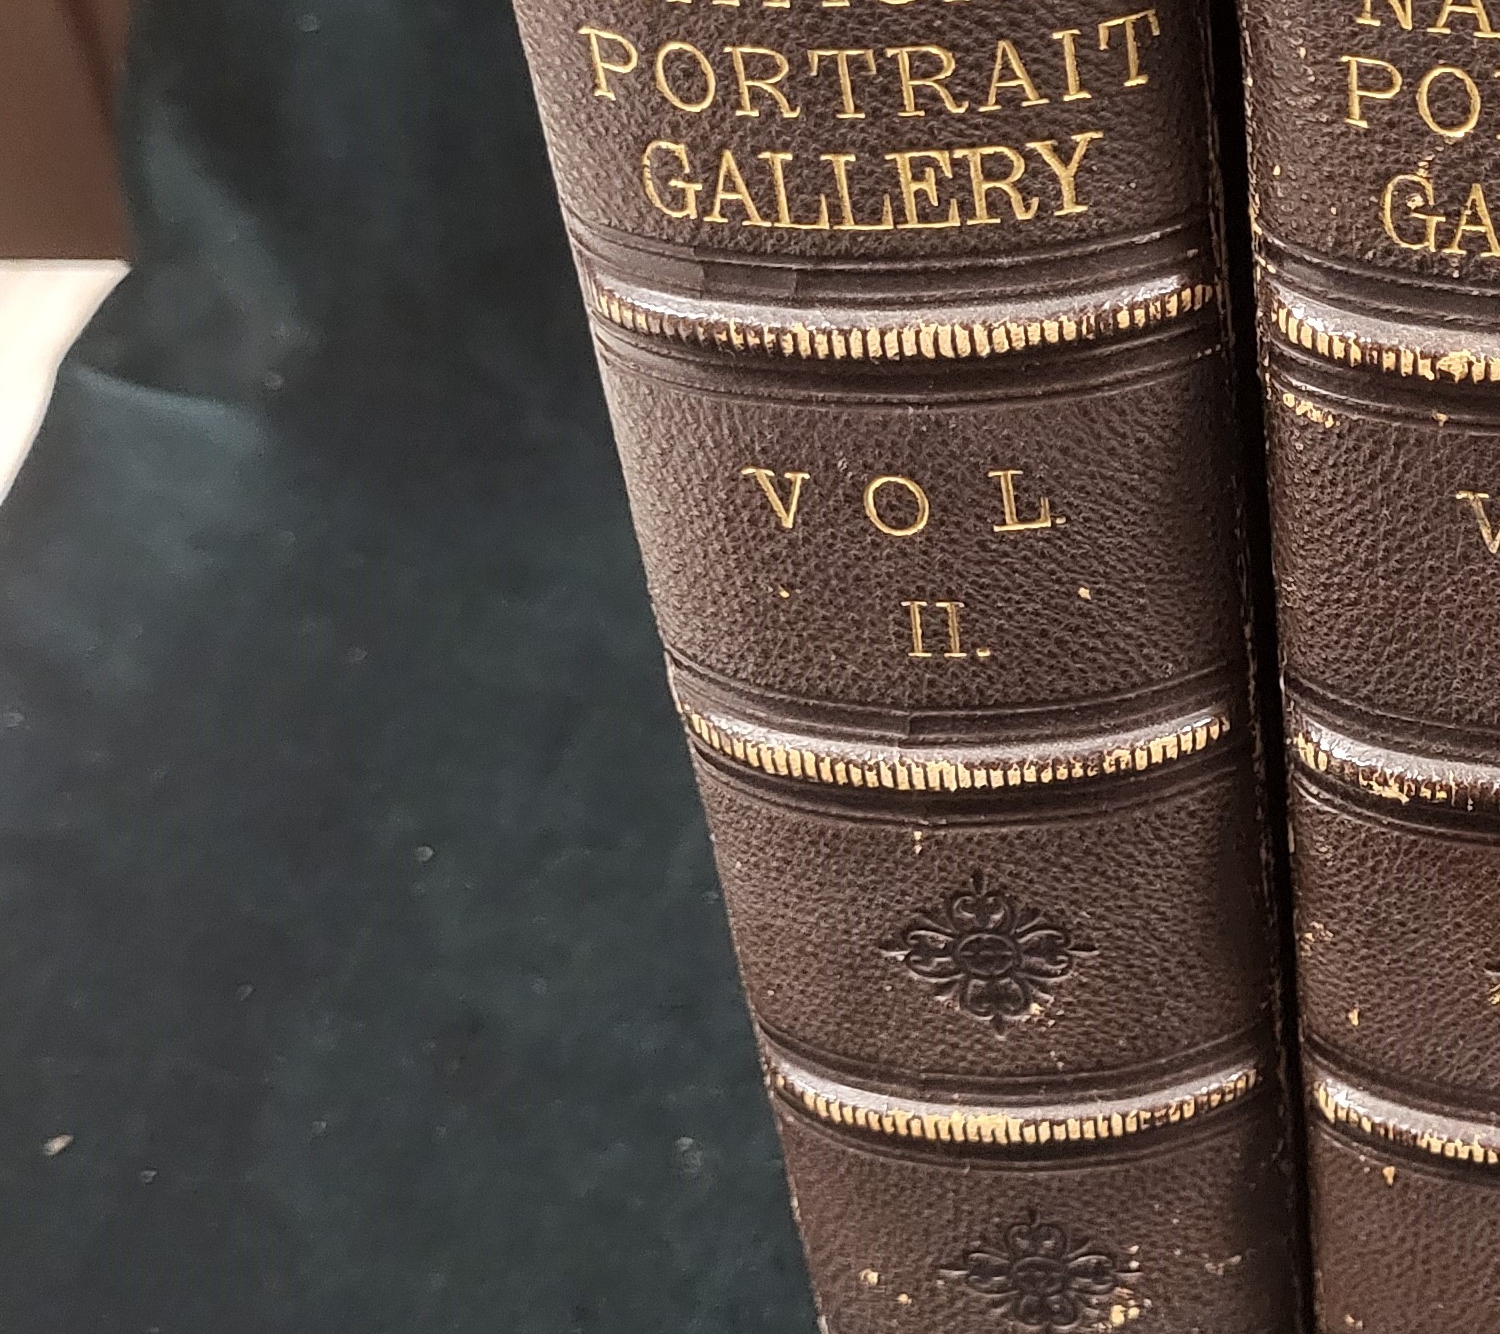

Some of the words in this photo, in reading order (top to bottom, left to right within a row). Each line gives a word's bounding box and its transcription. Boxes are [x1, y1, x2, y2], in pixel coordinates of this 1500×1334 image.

[577, 8, 1161, 120] PORTRAIT
[641, 130, 1104, 231] GALLERY
[900, 600, 992, 659] II.
